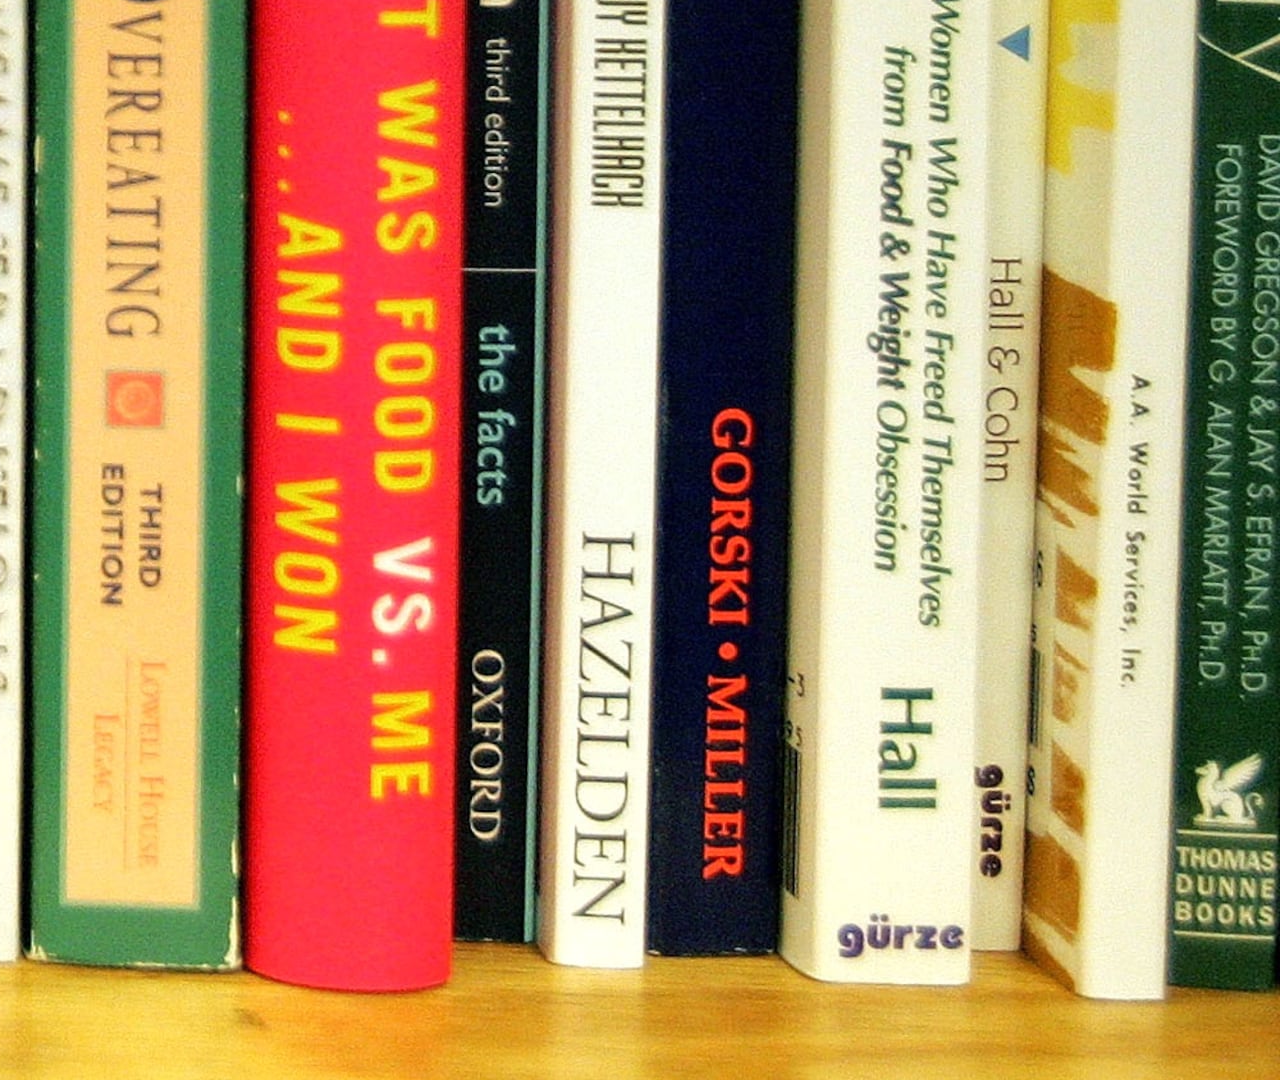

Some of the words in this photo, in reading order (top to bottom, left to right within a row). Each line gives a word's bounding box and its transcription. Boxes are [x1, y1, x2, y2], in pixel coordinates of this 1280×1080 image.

[485, 37, 510, 104] third
[880, 44, 911, 127] from
[376, 80, 437, 256] WAS
[483, 113, 507, 209] edition
[879, 140, 912, 232] Food
[928, 135, 960, 219] Who
[926, 222, 956, 319] Have
[1211, 142, 1244, 308] FOREWORD
[866, 277, 913, 389] Weight
[988, 256, 1023, 334] Hall
[374, 296, 437, 491] FOOD
[477, 322, 507, 393] the
[924, 328, 956, 424] Freed
[475, 406, 519, 508] facts
[873, 394, 910, 574] Obsession
[983, 382, 1020, 484] Cohn
[1129, 442, 1150, 517] World
[1204, 401, 1233, 475] ALAN
[100, 462, 125, 607] EDITION
[138, 482, 163, 589] THIRD
[272, 477, 338, 656] WON
[708, 407, 753, 628] GORSKI
[920, 430, 954, 629] Themselves
[1197, 485, 1231, 610] MARLATT,
[1239, 516, 1271, 620] EFRAN,
[370, 536, 433, 667] VS.
[1123, 527, 1147, 636] Services,
[369, 688, 432, 801] ME
[471, 649, 506, 843] OXFORD
[571, 530, 637, 926] HAZELDEN
[701, 674, 748, 880] MILLER
[877, 685, 938, 812] Hall
[974, 765, 1004, 879] gürze
[1175, 845, 1278, 873] THOMAS
[838, 914, 964, 959] gürze
[1174, 900, 1276, 927] BOOKS
[1175, 872, 1276, 900] DUNNE
